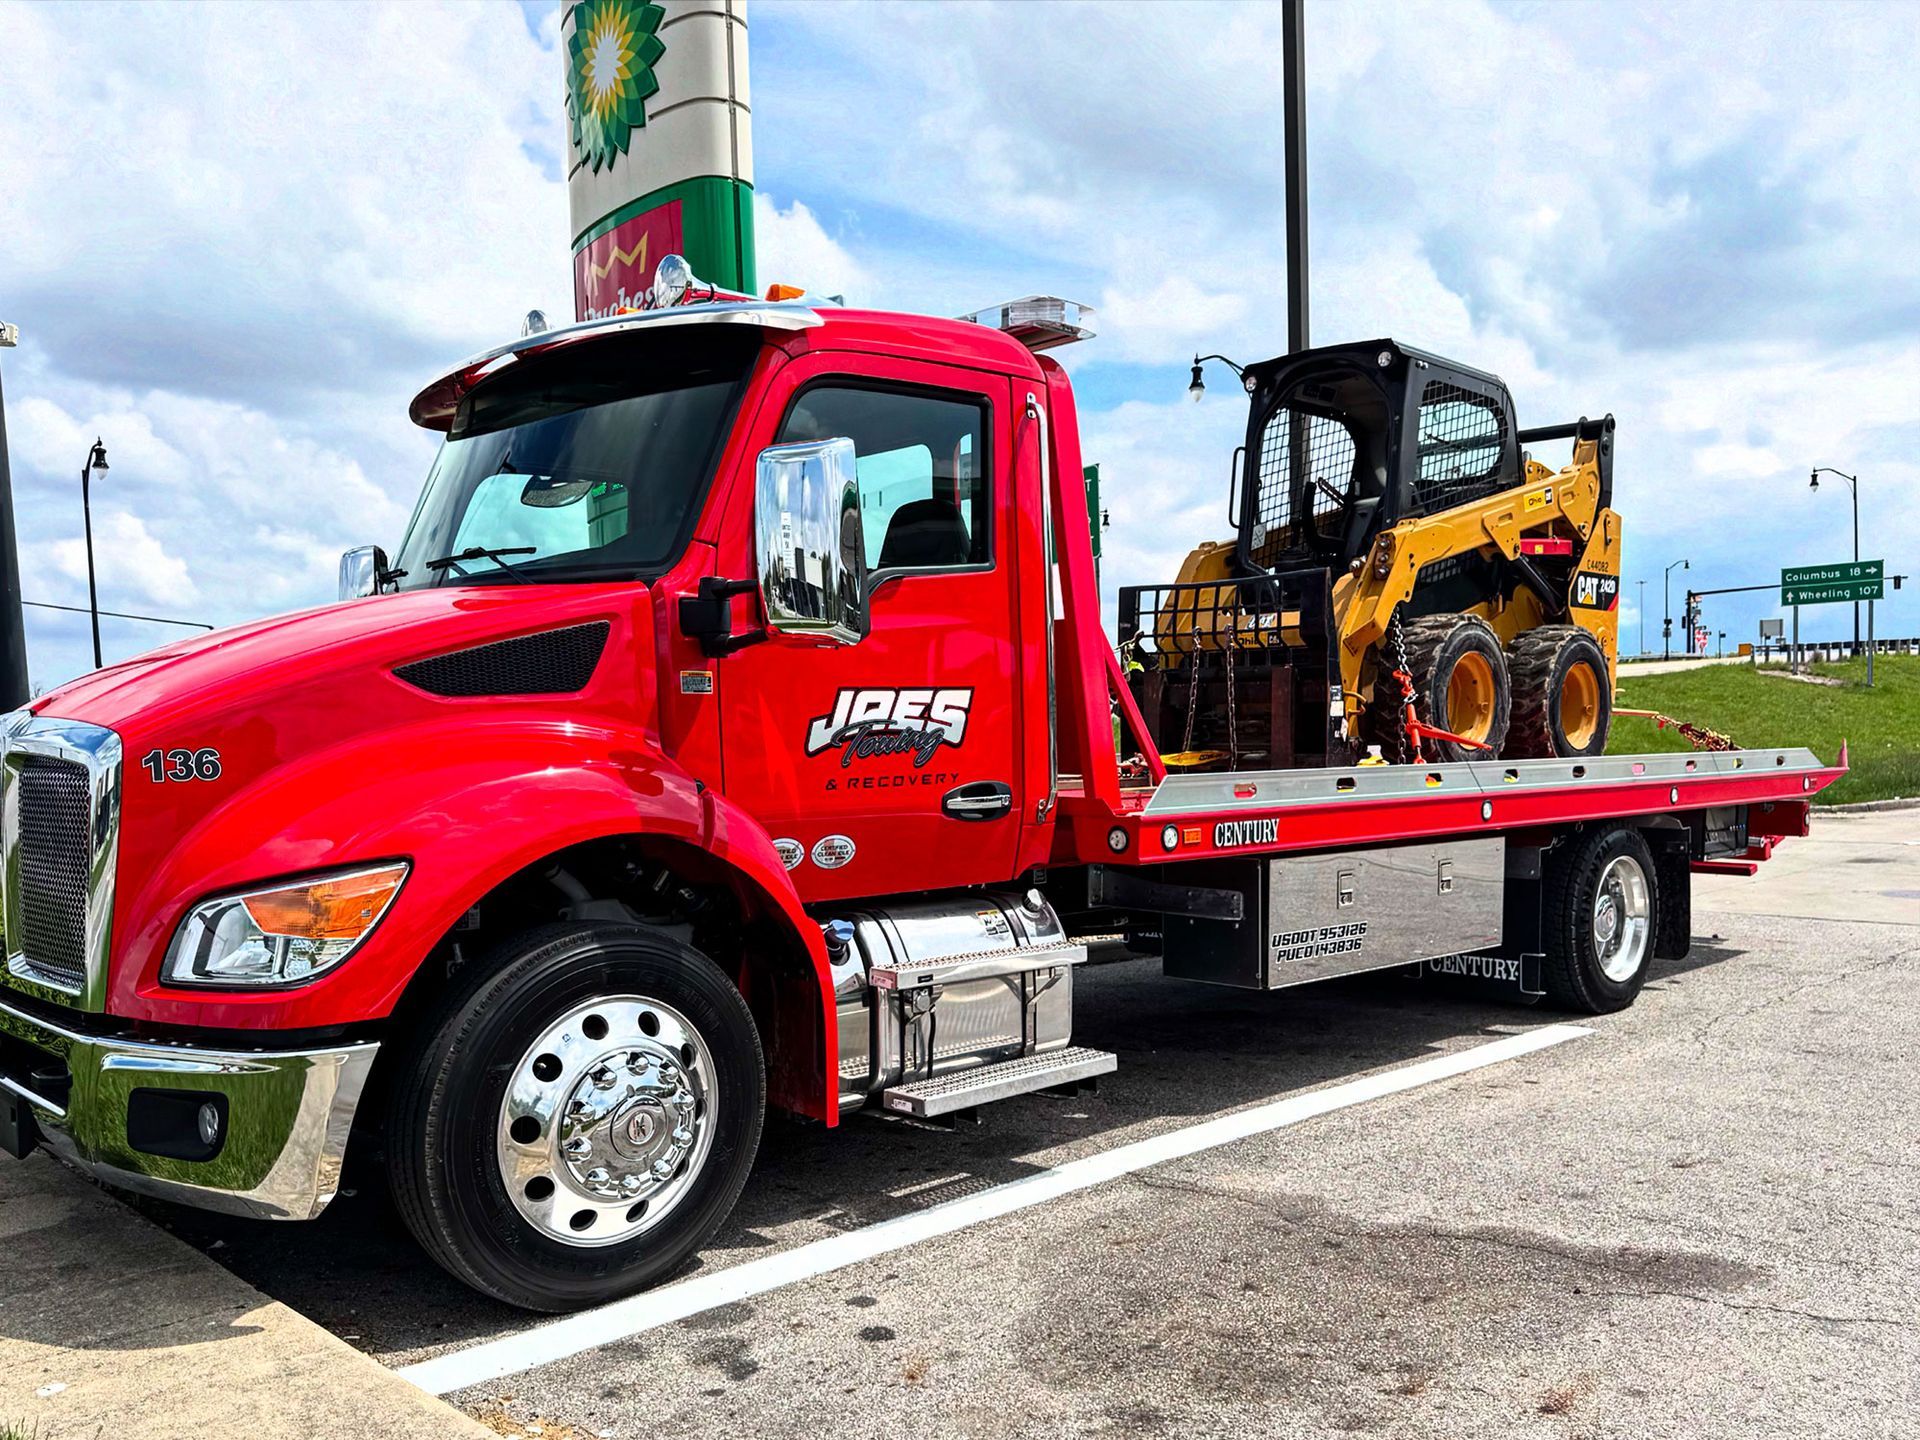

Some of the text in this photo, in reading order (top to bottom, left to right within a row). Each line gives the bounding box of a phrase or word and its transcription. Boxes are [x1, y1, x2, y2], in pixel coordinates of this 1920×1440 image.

[1785, 567, 1861, 582] Columbus 18
[1577, 575, 1599, 605] CAT
[1799, 586, 1879, 600] Wheeling 107
[805, 686, 975, 757] JOES
[830, 718, 946, 768] Towing
[142, 747, 222, 783] 136
[825, 772, 960, 791] & RECOVERY
[1213, 817, 1280, 848] CENTURY
[1272, 921, 1368, 948] USDOT 953126
[1276, 937, 1363, 963] PUCO 143836
